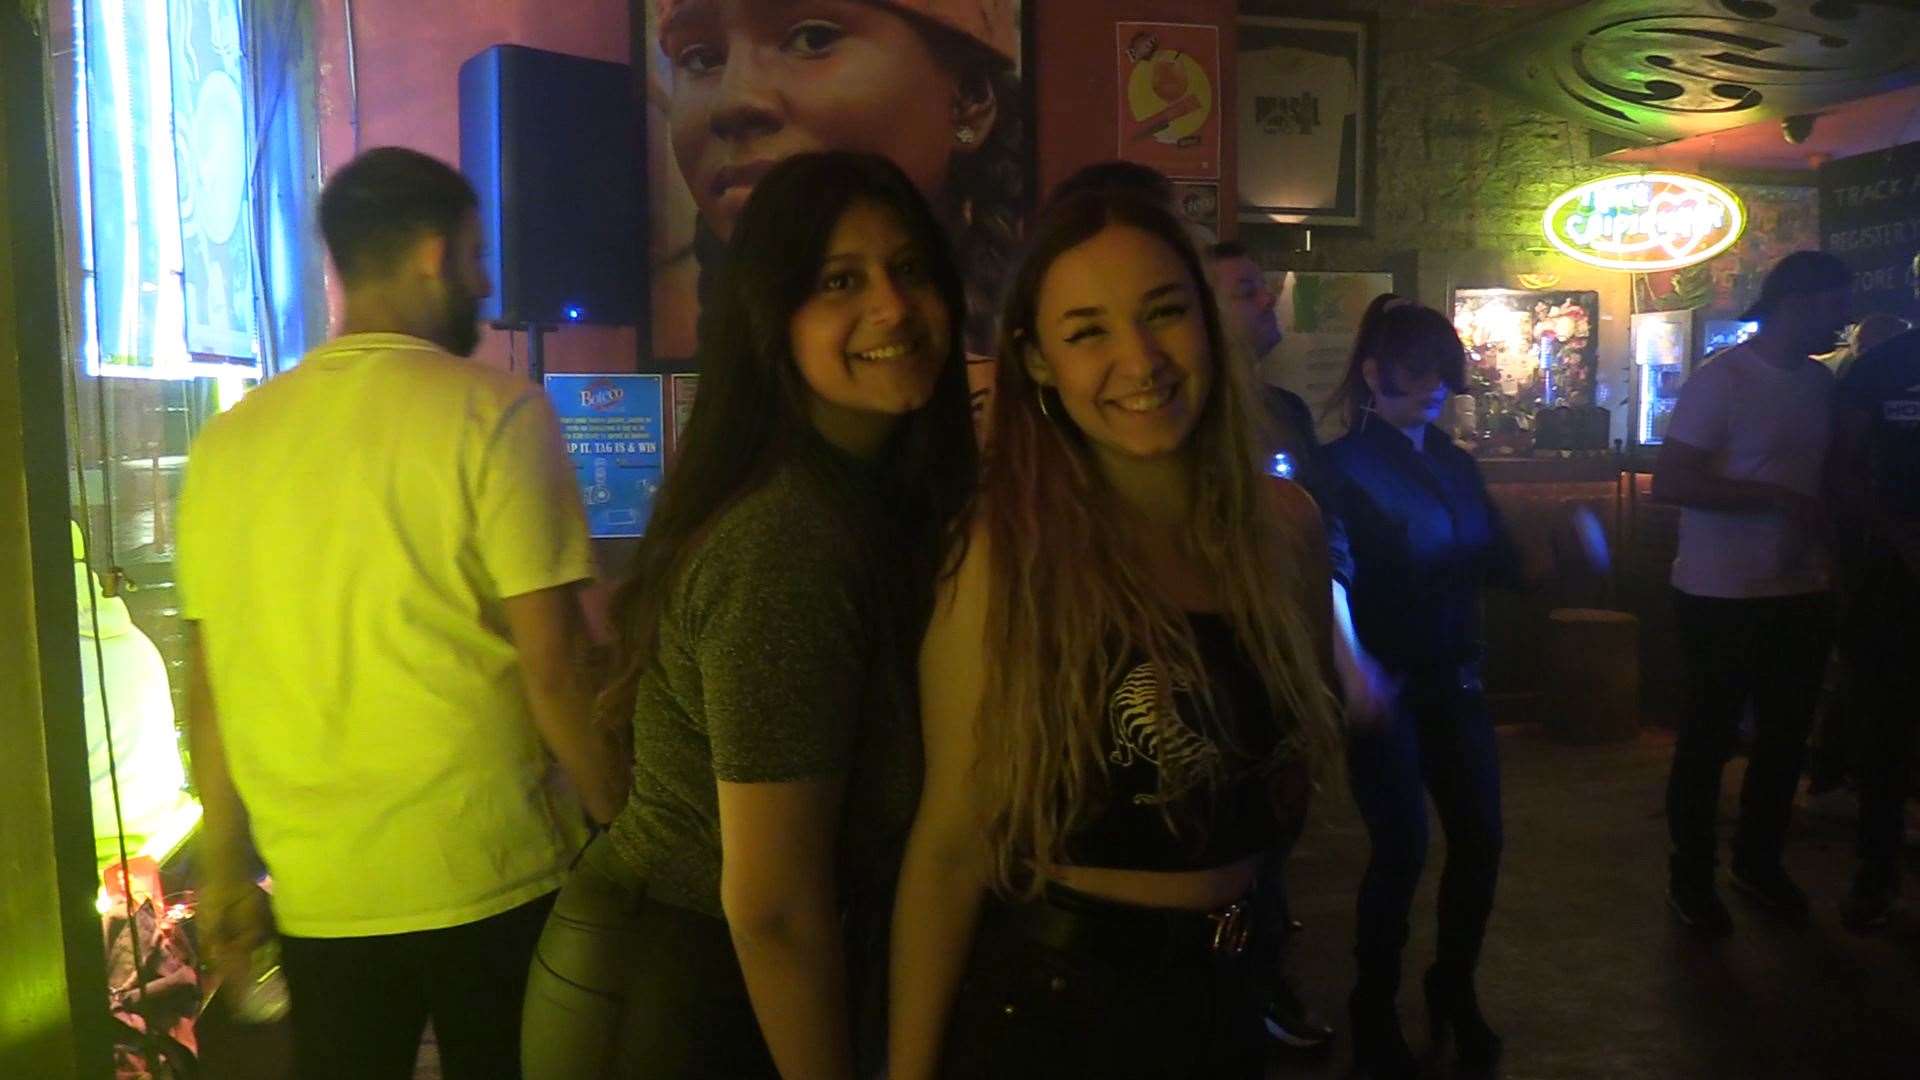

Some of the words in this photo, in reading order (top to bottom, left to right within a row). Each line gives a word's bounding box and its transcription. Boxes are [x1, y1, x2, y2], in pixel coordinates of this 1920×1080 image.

[1832, 178, 1904, 207] TRACK
[1851, 264, 1896, 293] TORE
[594, 442, 612, 454] TAG
[639, 442, 657, 454] WIN
